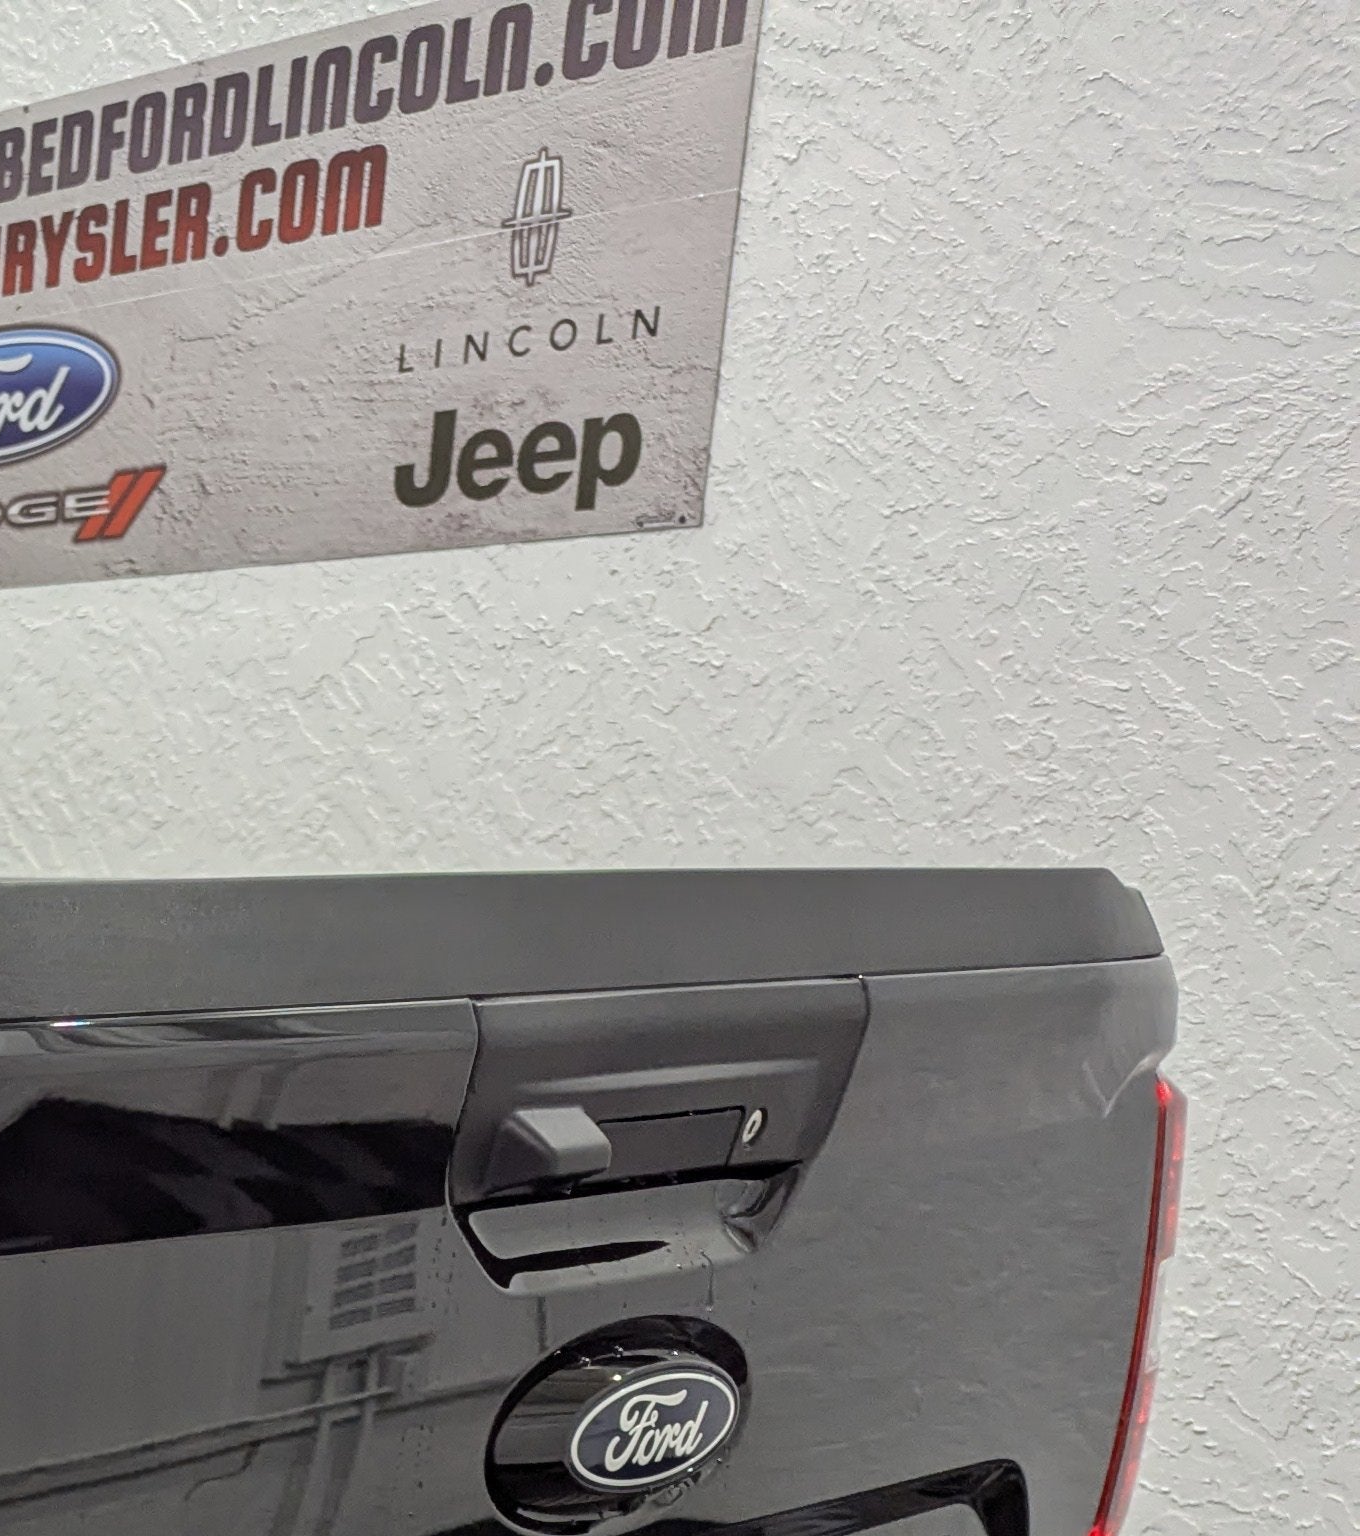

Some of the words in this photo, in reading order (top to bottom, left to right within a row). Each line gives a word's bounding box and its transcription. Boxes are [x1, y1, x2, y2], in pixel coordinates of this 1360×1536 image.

[397, 306, 660, 374] LINCOLN
[394, 409, 643, 512] Jeep
[604, 1389, 709, 1472] Ford
